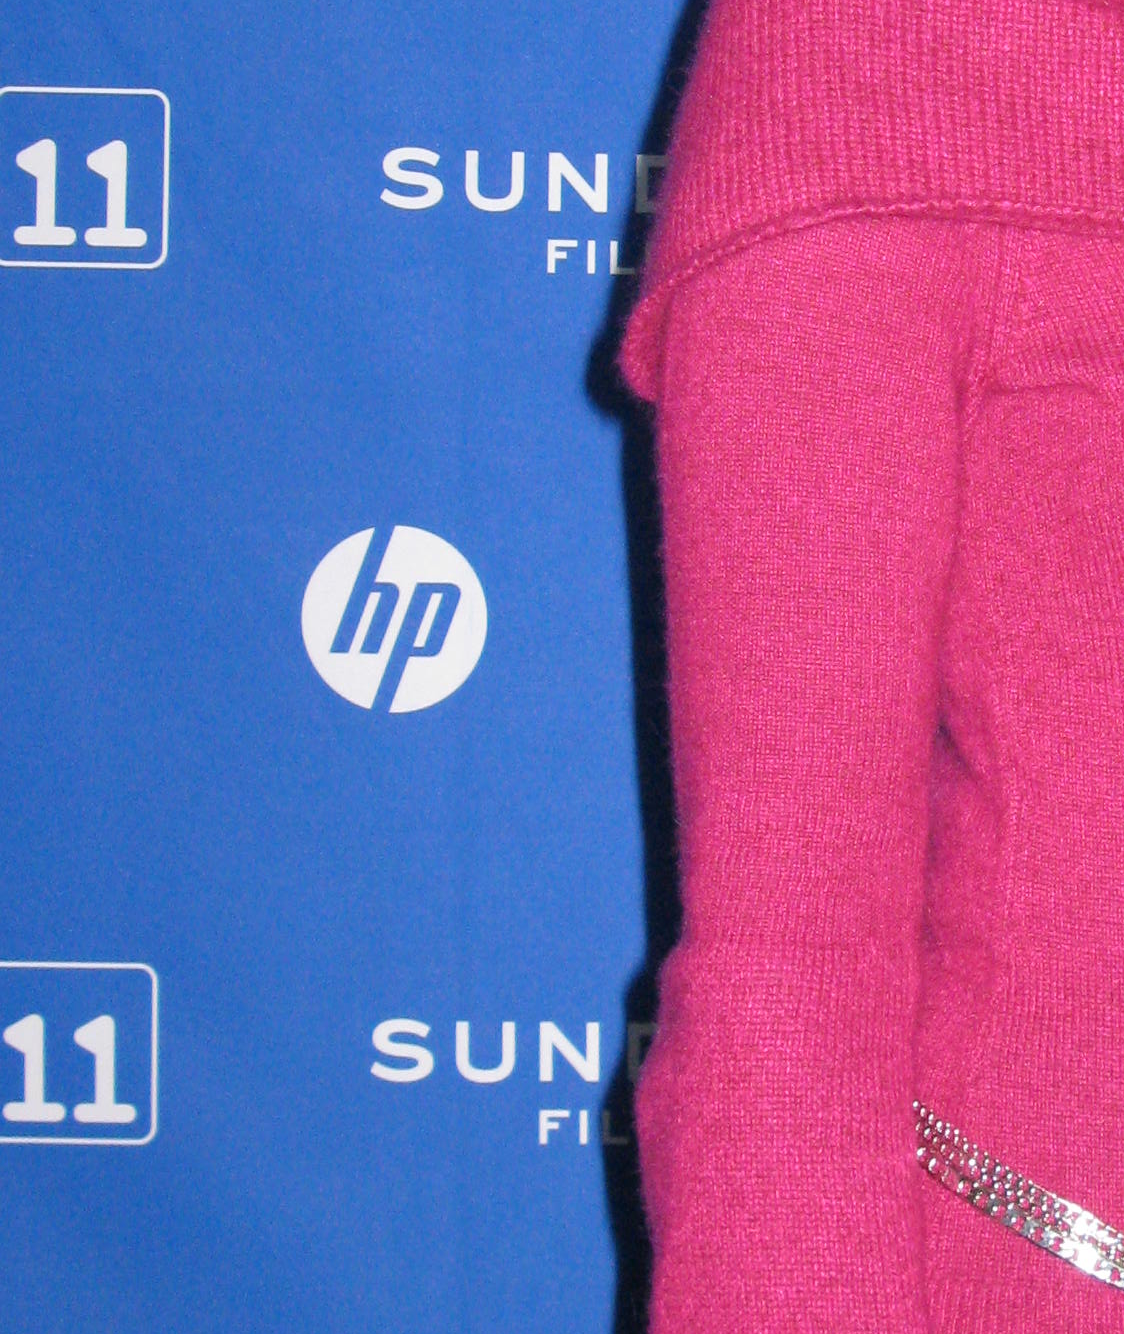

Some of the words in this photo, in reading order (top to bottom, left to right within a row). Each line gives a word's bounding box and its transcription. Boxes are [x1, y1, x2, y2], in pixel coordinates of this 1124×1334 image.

[14, 138, 148, 247] 11
[330, 526, 461, 711] hp
[3, 1013, 137, 1123] 11
